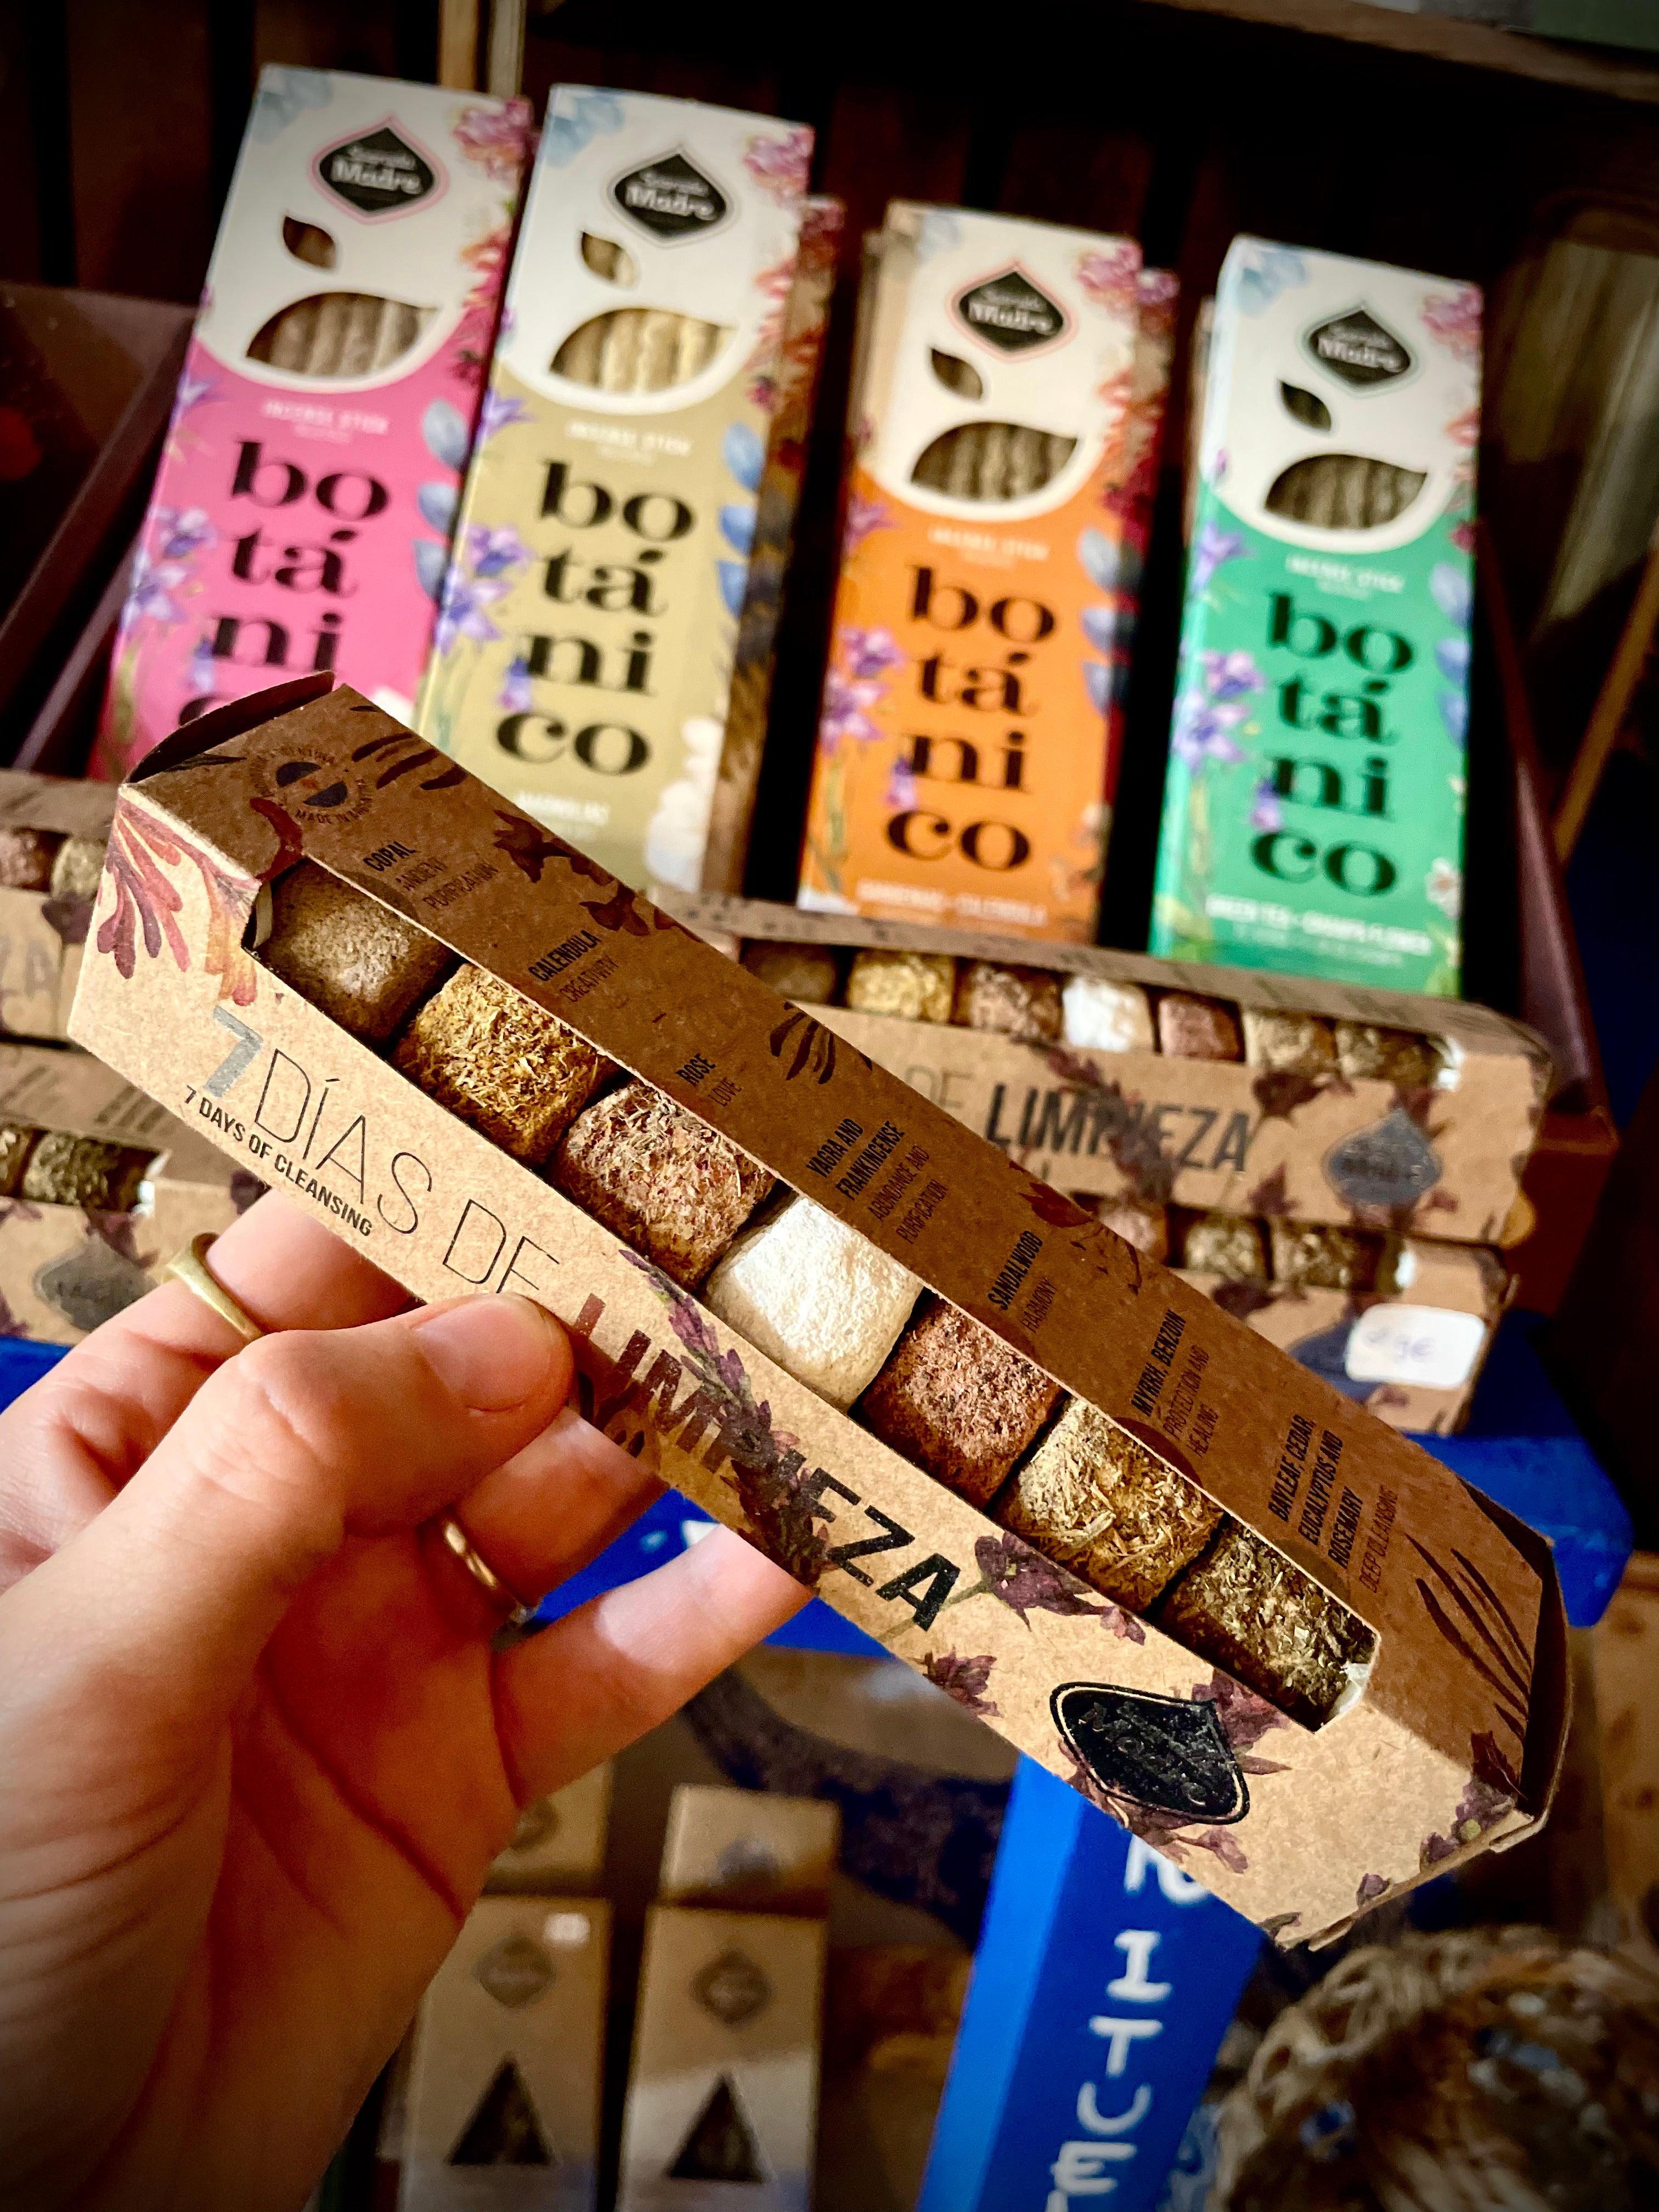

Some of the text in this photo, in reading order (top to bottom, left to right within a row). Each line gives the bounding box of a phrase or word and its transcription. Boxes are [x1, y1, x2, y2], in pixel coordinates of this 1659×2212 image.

[232, 441, 390, 521] bo
[539, 458, 696, 541] bo
[231, 524, 359, 597] tá
[540, 544, 670, 619] tá
[907, 565, 1056, 644] bo
[1266, 590, 1415, 674] bo
[210, 611, 342, 671] ni
[524, 630, 657, 697] ni
[913, 648, 1039, 716] tá
[1276, 675, 1400, 746] tá
[496, 710, 653, 776] co
[905, 730, 1033, 794] ni
[1266, 754, 1394, 822] ni
[363, 841, 416, 872] COPAL
[884, 809, 1032, 872] co
[1250, 831, 1397, 897] co
[528, 929, 602, 982] CALENDULA
[559, 954, 619, 1003] CREATIVITY
[675, 1053, 716, 1087] ROSE
[710, 1076, 743, 1107] LOVE
[203, 1004, 264, 1098] 7
[254, 1048, 432, 1234] DÍAS
[833, 1118, 864, 1149] AND
[183, 1085, 197, 1104] 7
[199, 1101, 245, 1142] DAYS
[249, 1133, 273, 1159] OF
[274, 1153, 374, 1237] CLEANSING
[836, 1121, 905, 1201] FRANKINCENSE
[868, 1145, 930, 1222] ABUNDANCE AND
[895, 1178, 949, 1244] PURIFICATION
[988, 1230, 1043, 1311] SANDALWOOD
[1021, 1277, 1058, 1333] HARMONY
[1150, 1308, 1187, 1367] BENZOIN
[1163, 1345, 1209, 1440] PROTECTION AND
[1186, 1404, 1218, 1458] HEALING
[1268, 1414, 1317, 1522] BAYLEAF, CEDAR,
[1297, 1430, 1343, 1545] EUCALYPTUS AND
[1327, 1485, 1363, 1570] ROSEMARY
[1359, 1484, 1398, 1594] DEEP CLEANSING
